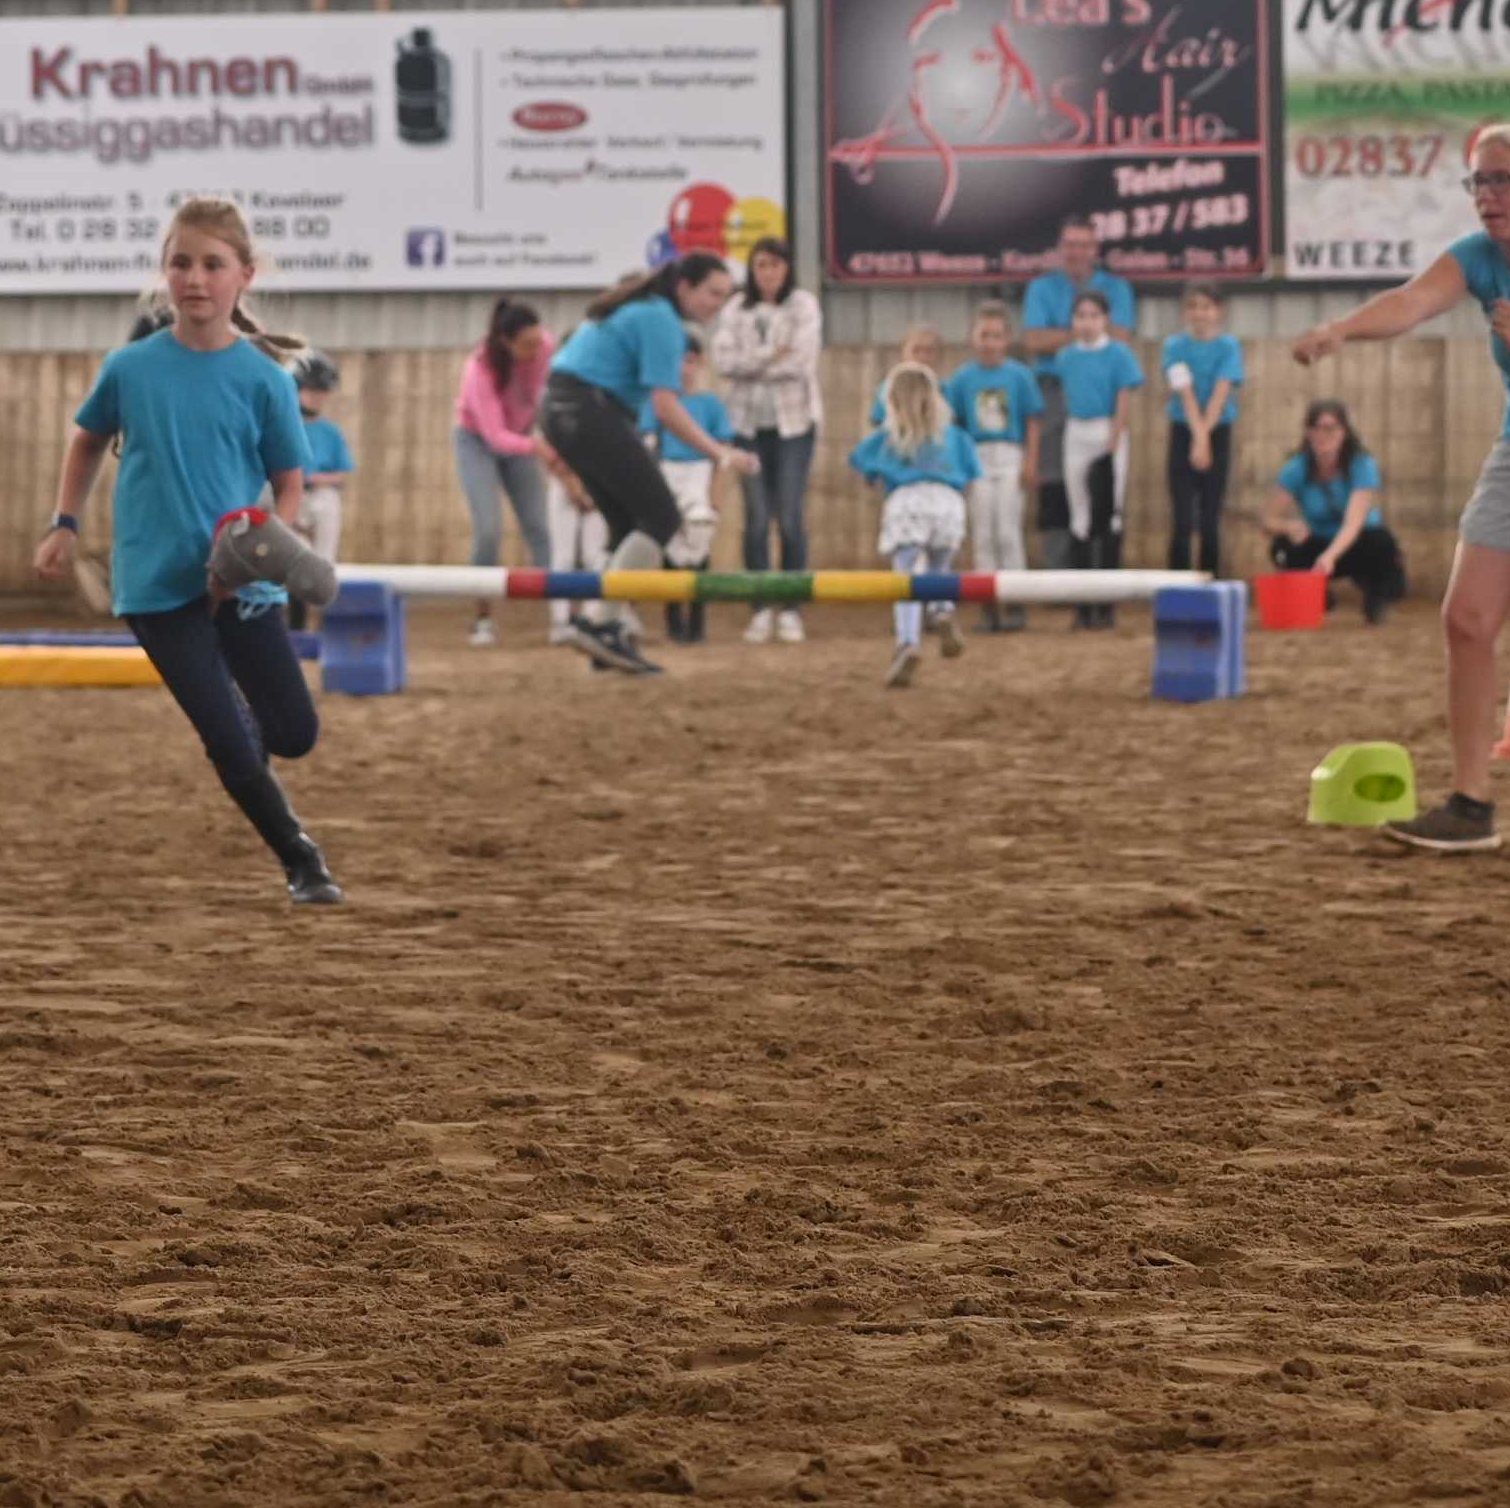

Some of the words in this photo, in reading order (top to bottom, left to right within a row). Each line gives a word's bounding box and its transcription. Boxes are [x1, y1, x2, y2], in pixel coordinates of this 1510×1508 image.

[30, 44, 298, 100] Krahnen
[1042, 72, 1237, 147] Studio
[1113, 158, 1226, 198] Telefon
[1294, 132, 1446, 178] 02837
[1294, 241, 1416, 268] WEEZE
